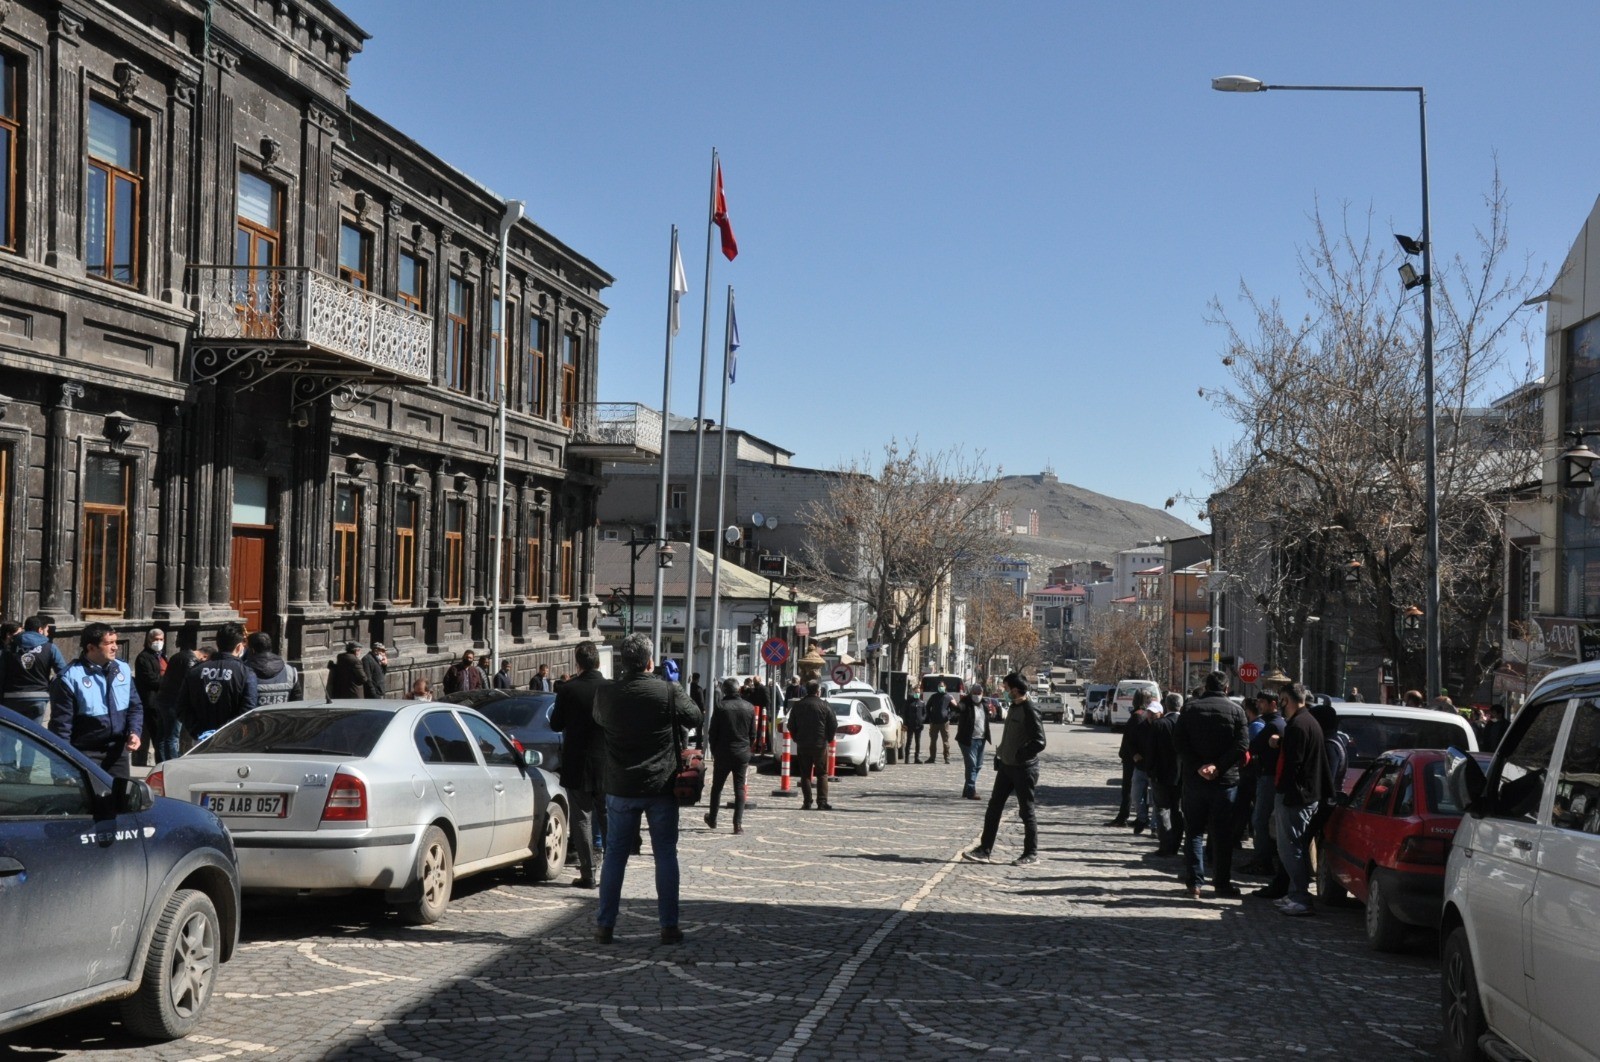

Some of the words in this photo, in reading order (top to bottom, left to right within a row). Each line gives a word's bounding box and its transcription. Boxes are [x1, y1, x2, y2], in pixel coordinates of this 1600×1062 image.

[1240, 668, 1258, 676] DUR
[208, 798, 225, 812] 36
[228, 798, 252, 812] AAB
[256, 799, 280, 812] 057
[80, 829, 139, 844] STEPWAY
